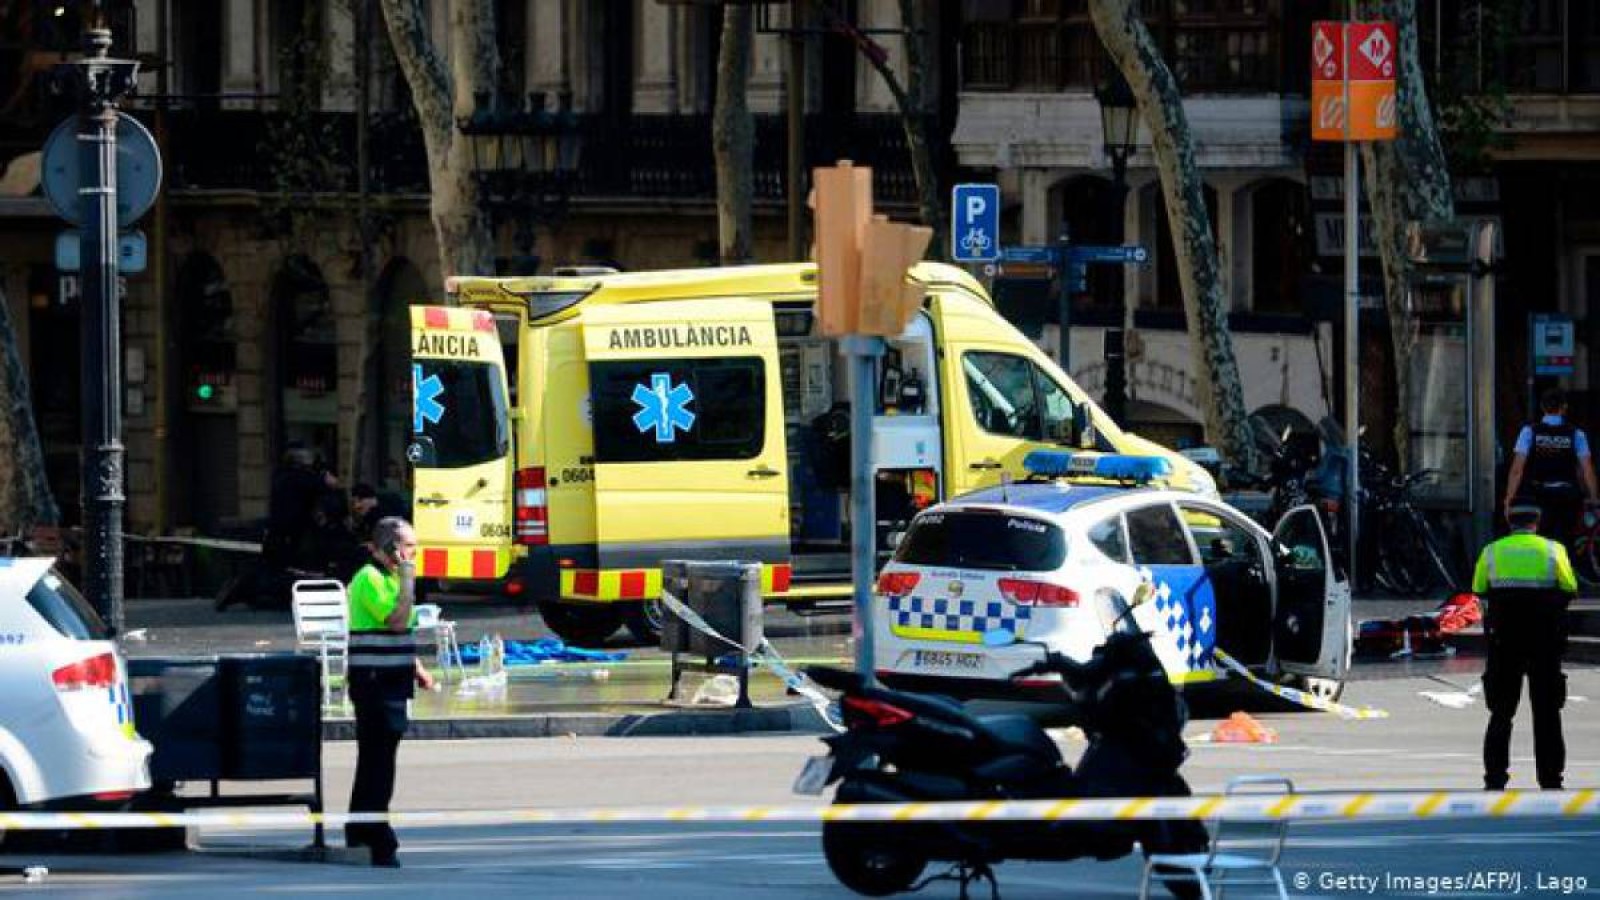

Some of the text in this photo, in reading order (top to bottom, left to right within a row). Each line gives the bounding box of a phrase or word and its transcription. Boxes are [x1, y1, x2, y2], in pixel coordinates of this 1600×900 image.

[1371, 39, 1384, 57] M
[966, 196, 986, 224] P
[609, 320, 752, 349] AMBULÀNCIA
